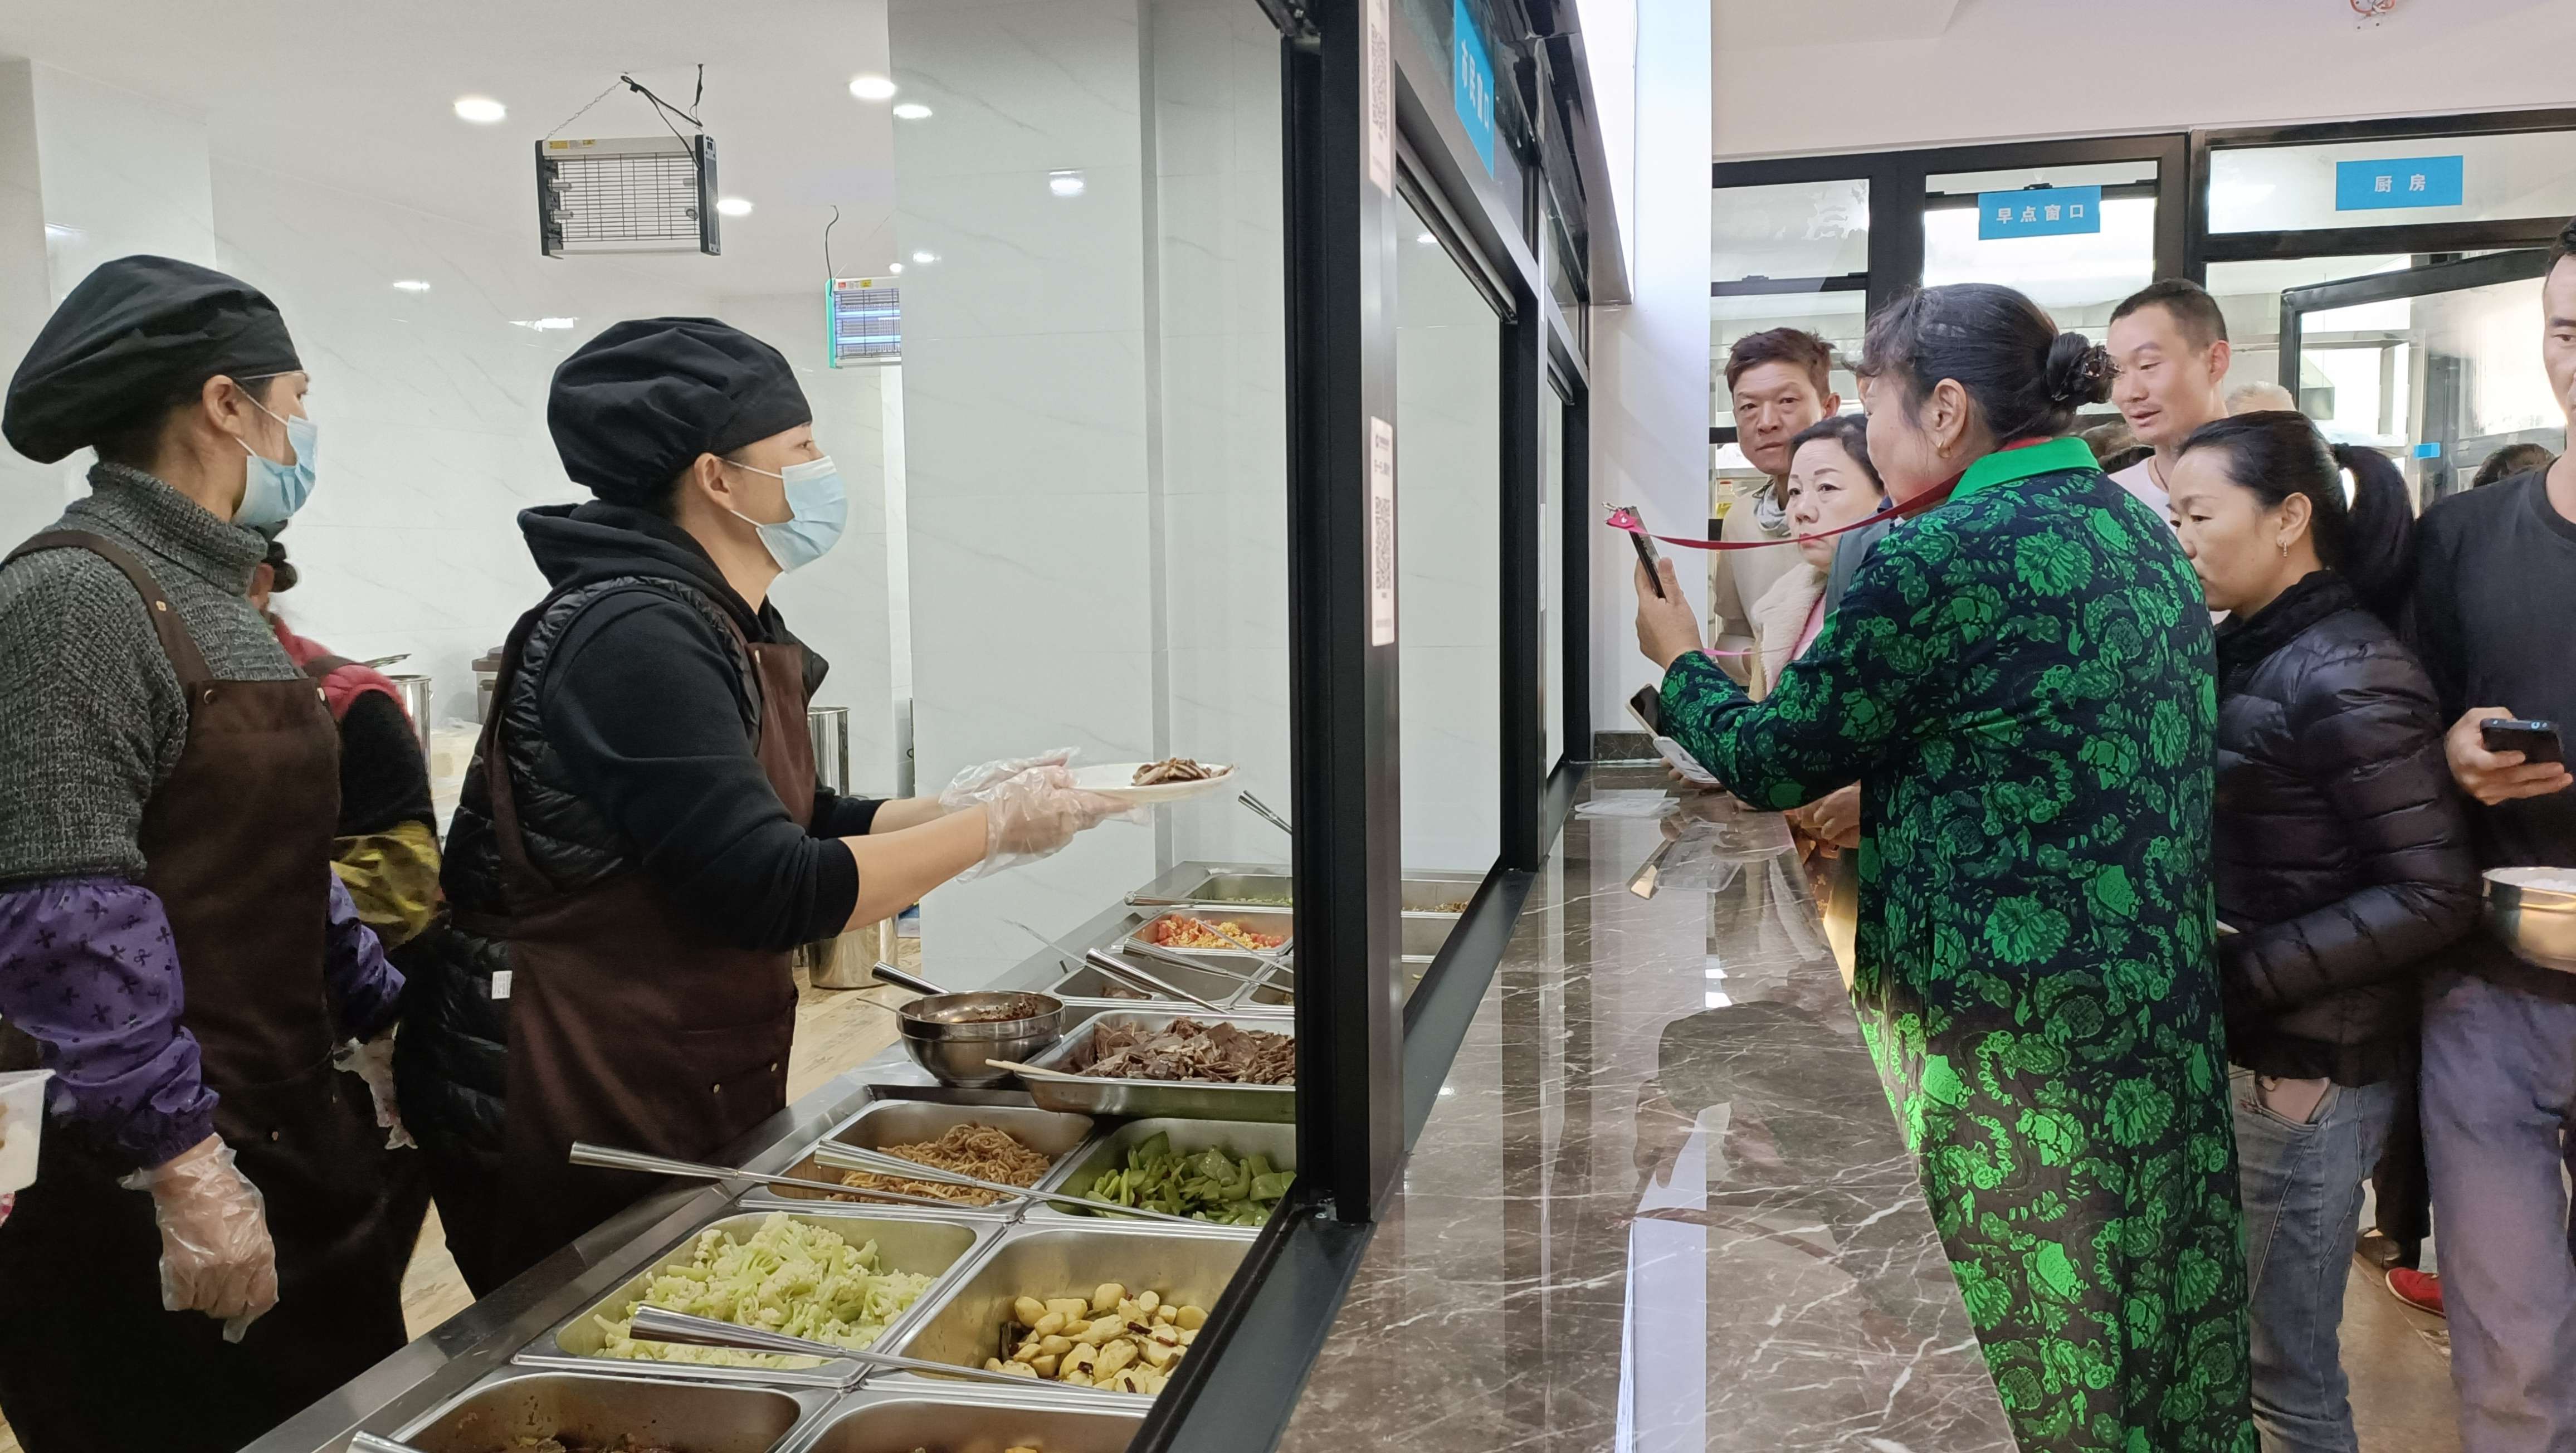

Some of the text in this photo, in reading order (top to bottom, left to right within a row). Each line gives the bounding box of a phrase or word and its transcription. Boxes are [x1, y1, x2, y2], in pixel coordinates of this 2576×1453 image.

[2374, 174, 2426, 193] 厨房
[1996, 204, 2084, 224] 早点窗口
